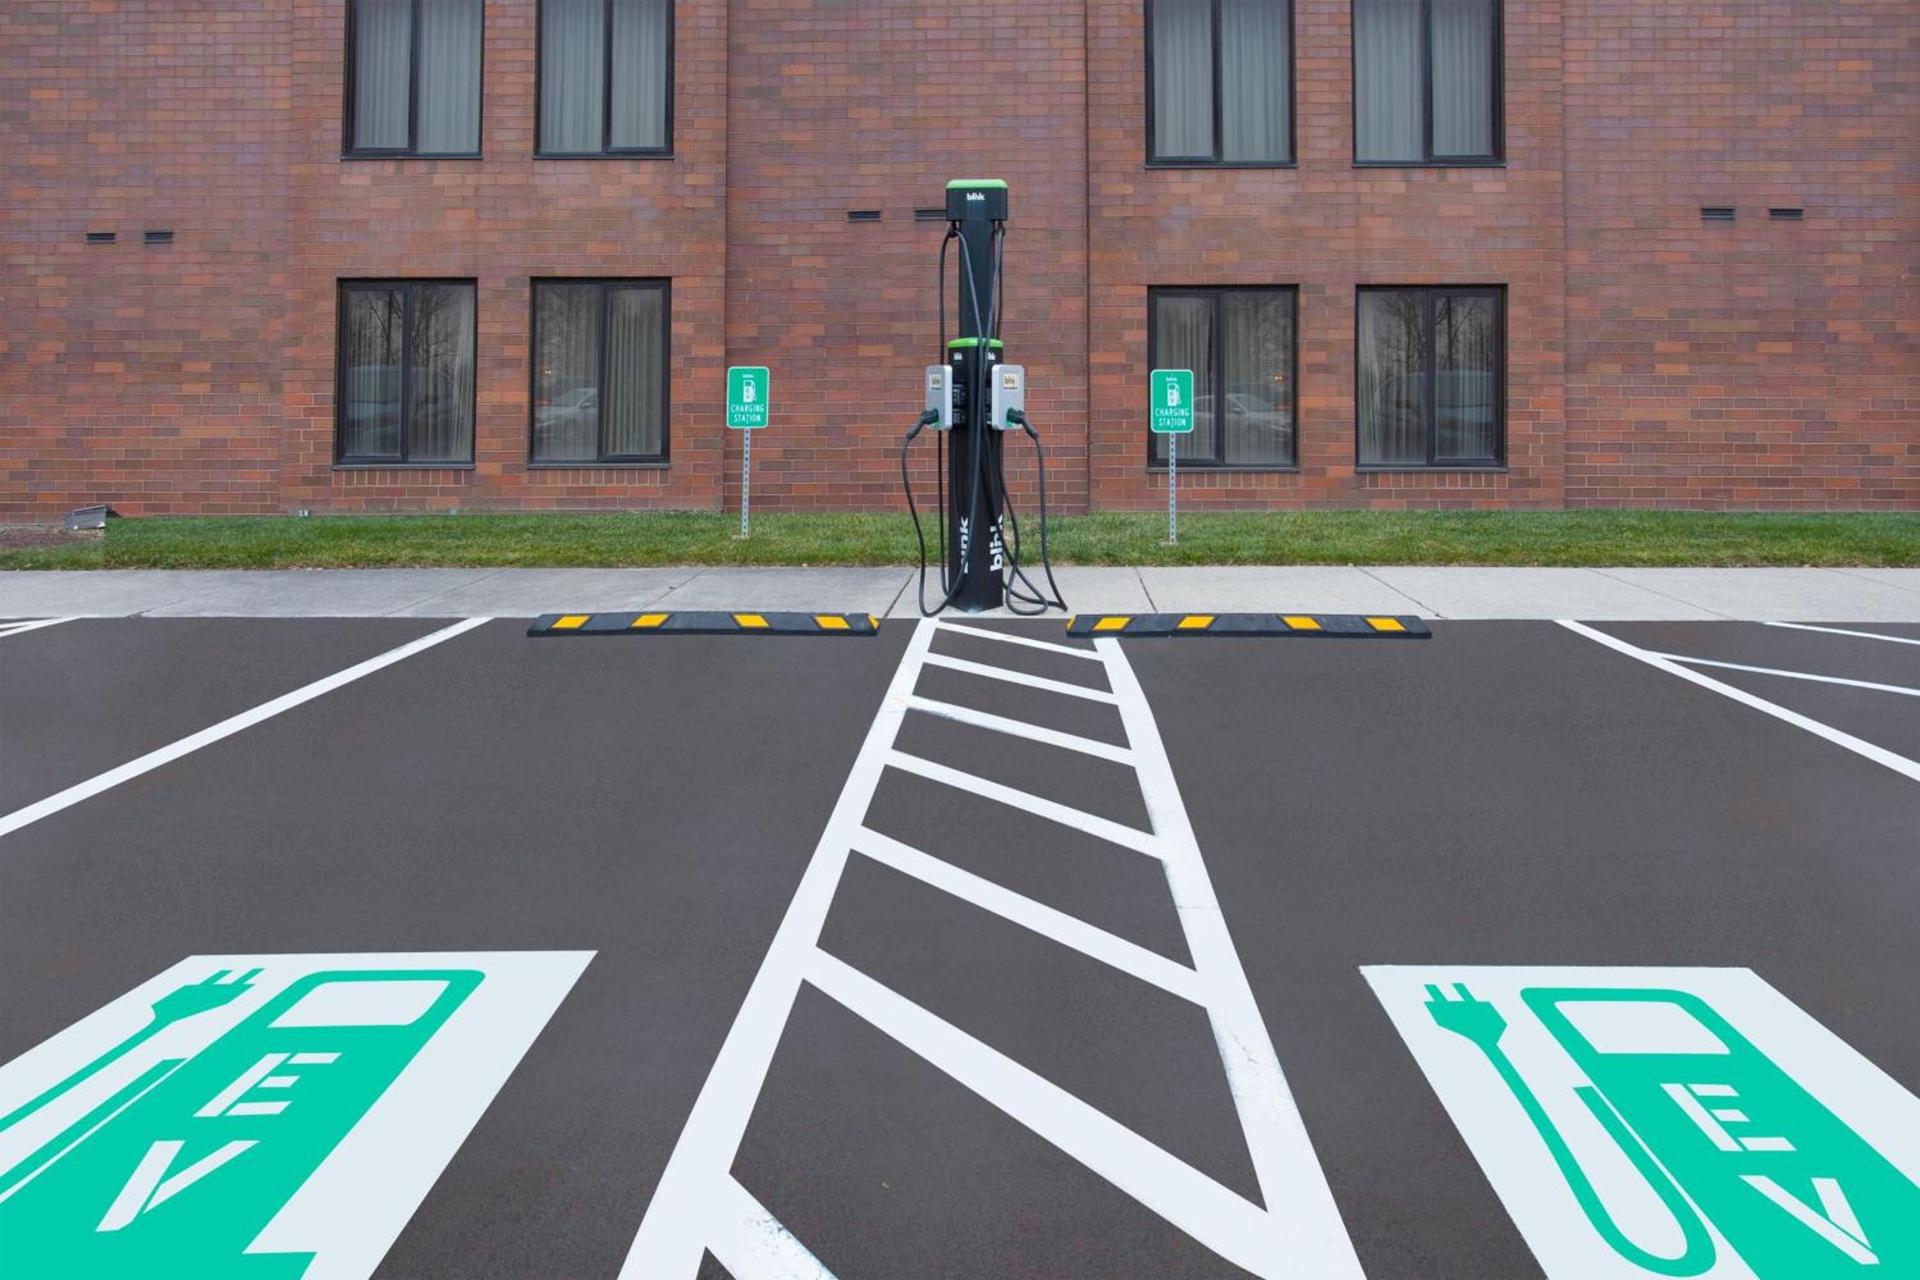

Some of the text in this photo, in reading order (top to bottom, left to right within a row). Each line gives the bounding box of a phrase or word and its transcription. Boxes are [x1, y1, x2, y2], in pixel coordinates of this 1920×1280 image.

[966, 192, 985, 201] blink
[730, 403, 765, 413] CHARGING
[1155, 407, 1190, 417] CHARGING
[734, 413, 761, 422] STATION
[1159, 417, 1186, 427] STATION
[95, 1052, 343, 1232] EV
[1659, 1083, 1880, 1265] EV
